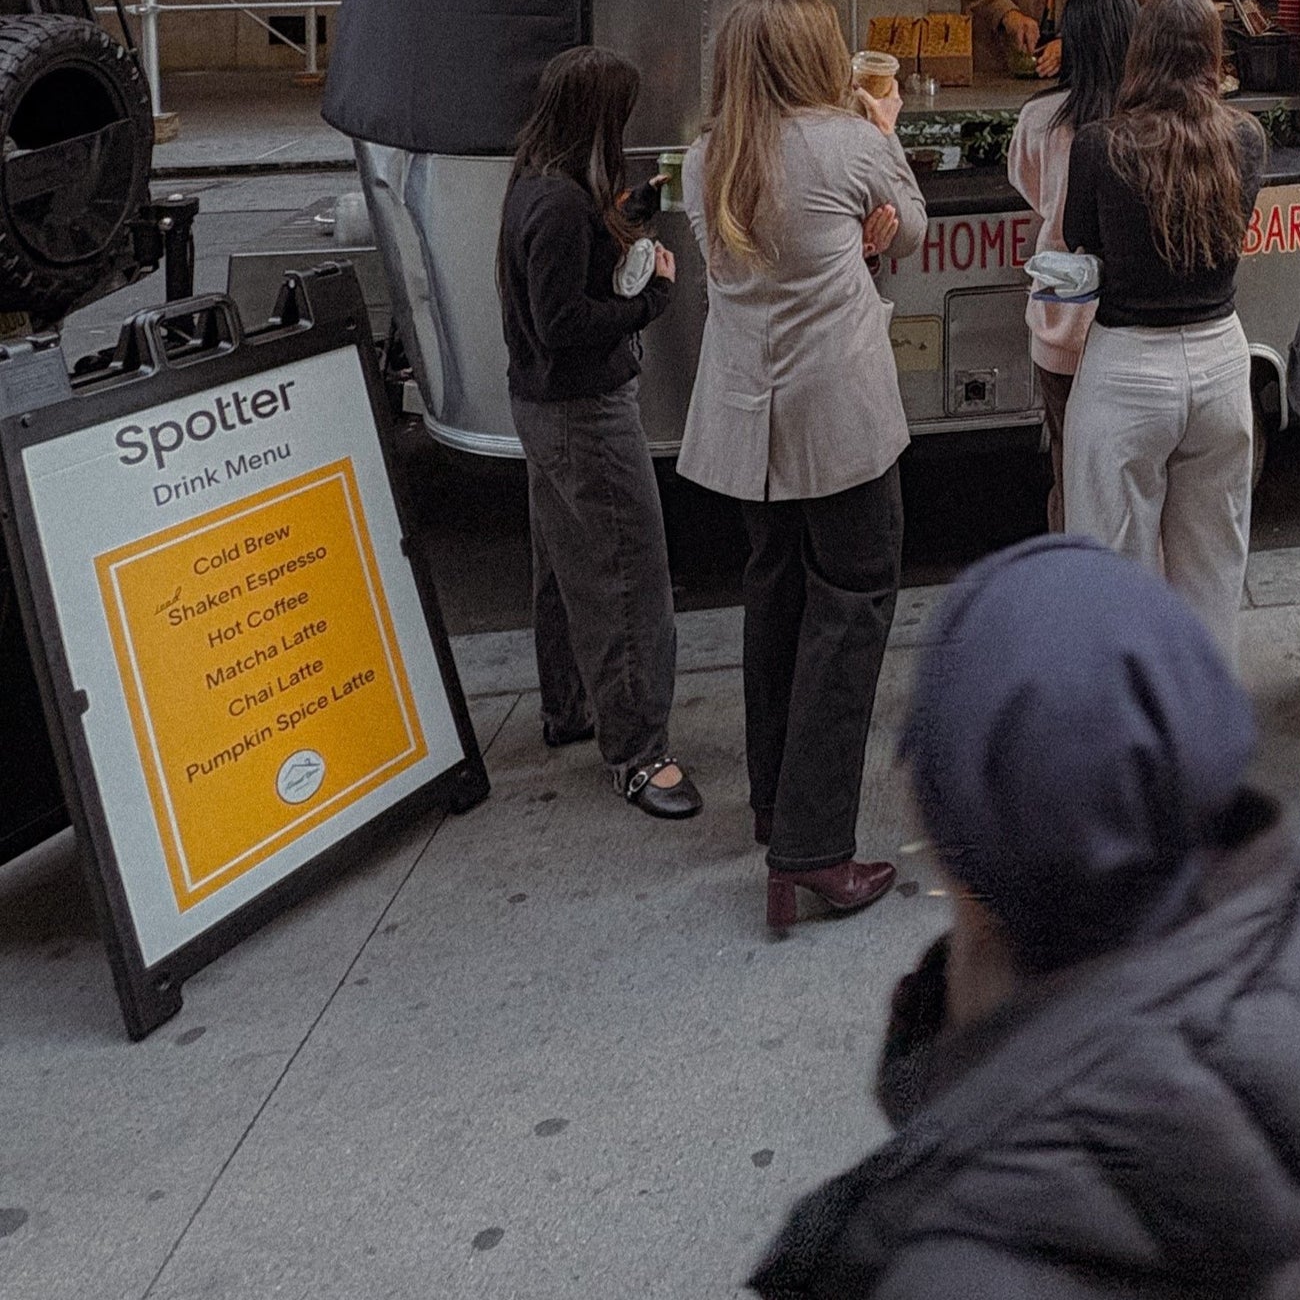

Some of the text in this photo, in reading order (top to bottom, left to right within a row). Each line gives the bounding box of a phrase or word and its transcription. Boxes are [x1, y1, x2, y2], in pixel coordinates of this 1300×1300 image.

[922, 218, 1032, 273] HOME
[115, 380, 295, 470] Spotter
[153, 443, 291, 506] Drink Menu
[193, 525, 290, 575] Cold Brew
[168, 546, 327, 626] Shaken Espresso
[208, 591, 309, 648] Hot Coffee
[205, 620, 328, 690] Matcha Latte
[229, 660, 324, 716] Chai Latte
[186, 726, 273, 783] Pumpkin
[276, 695, 328, 732] Spice
[331, 669, 375, 702] Latte
